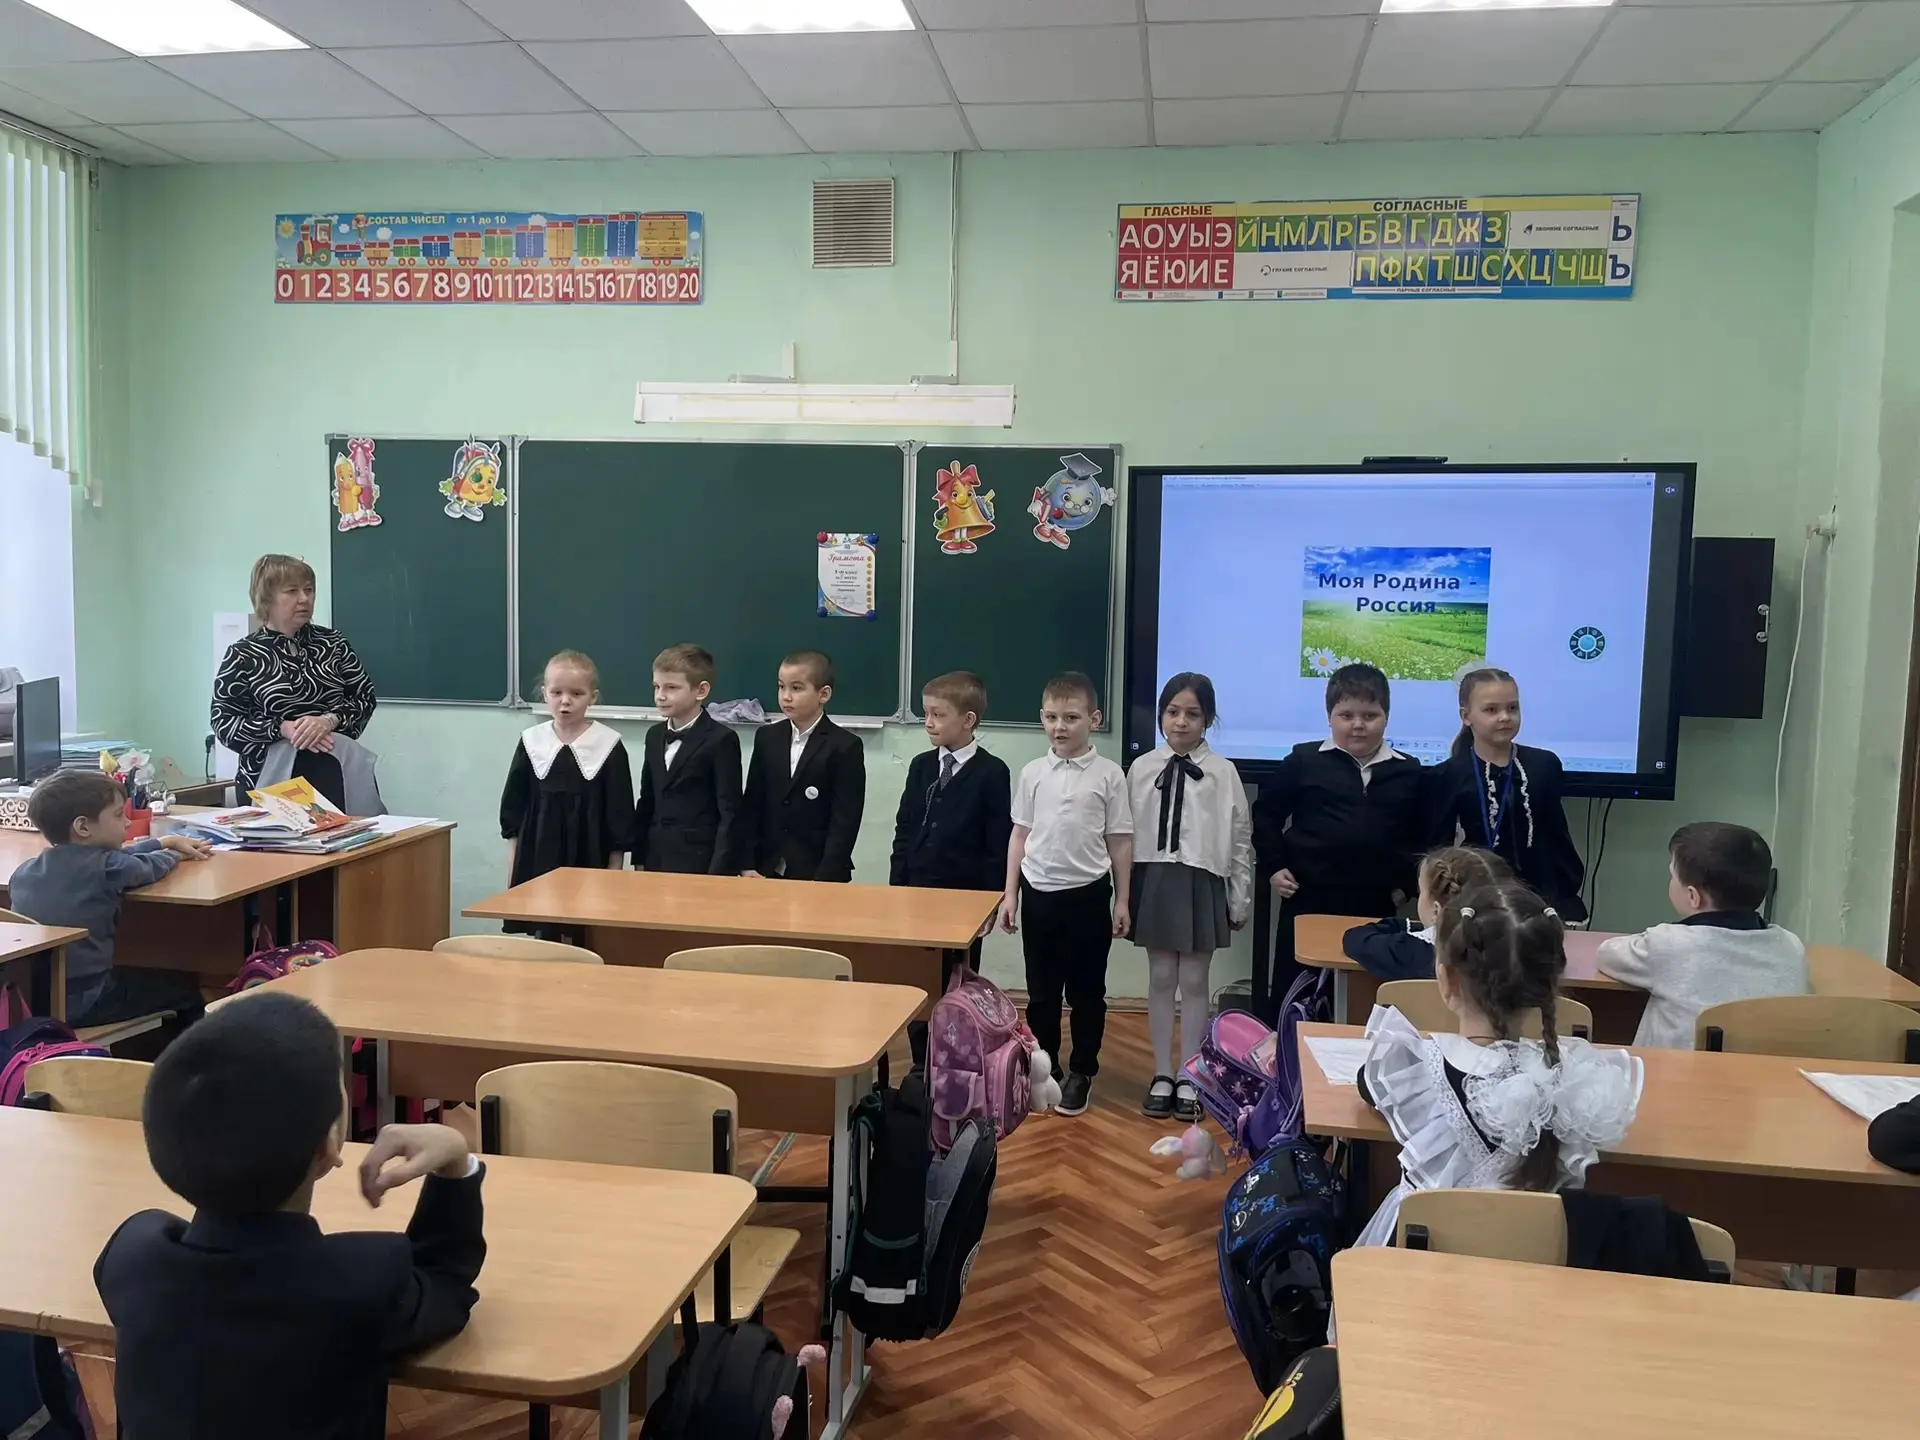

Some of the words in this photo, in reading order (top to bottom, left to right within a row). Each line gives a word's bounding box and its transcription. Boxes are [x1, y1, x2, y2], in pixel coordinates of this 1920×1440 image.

[1144, 205, 1213, 217] ГЛАСНЫЕ
[1373, 199, 1468, 212] СОГЛАСНЫЕ
[368, 216, 409, 225] СОСТАВ
[411, 216, 446, 225] ЧИСЕЛ
[470, 216, 476, 224] 1
[479, 217, 491, 225] до
[495, 216, 507, 224] 10
[1612, 216, 1632, 241] Ь
[1120, 224, 1140, 248] А
[1144, 224, 1164, 248] О
[1168, 224, 1186, 248] У
[1190, 223, 1210, 247] Ы
[1214, 222, 1232, 247] Э
[1238, 218, 1258, 247] Й
[1261, 222, 1280, 246] Н
[1284, 222, 1306, 246] М
[1308, 221, 1329, 245] Л
[1336, 221, 1353, 245] Р
[1358, 220, 1377, 244] Б
[1384, 220, 1401, 244] В
[1410, 219, 1425, 243] Г
[1432, 218, 1453, 246] Д
[1456, 218, 1480, 242] Ж
[1485, 217, 1502, 243] З
[1120, 260, 1138, 284] Я
[1145, 255, 1159, 284] Ё
[1164, 260, 1186, 284] Ю
[1189, 260, 1208, 283] И
[1214, 259, 1229, 283] Е
[1356, 257, 1376, 281] П
[1380, 256, 1401, 282] Ф
[1405, 256, 1424, 281] К
[1432, 256, 1450, 280] Т
[1454, 256, 1477, 281] Ш
[1481, 255, 1500, 280] С
[1505, 255, 1526, 280] Х
[1530, 255, 1550, 284] Ц
[1558, 255, 1577, 280] Ч
[1581, 255, 1603, 283] Щ
[1609, 255, 1630, 280] Ъ
[278, 273, 294, 298] 0
[300, 273, 310, 298] 1
[317, 273, 332, 298] 2
[336, 273, 350, 298] 3
[355, 273, 371, 298] 4
[375, 273, 390, 298] 5
[394, 273, 410, 298] 6
[414, 273, 429, 298] 7
[434, 273, 450, 298] 8
[454, 273, 470, 298] 9
[474, 273, 492, 298] 10
[494, 273, 512, 298] 11
[515, 273, 534, 298] 12
[535, 273, 553, 298] 13
[555, 273, 574, 298] 14
[576, 273, 595, 298] 15
[596, 273, 615, 298] 16
[616, 273, 636, 298] 17
[637, 273, 656, 298] 18
[658, 273, 678, 298] 19
[679, 273, 699, 298] 20
[828, 554, 865, 563] Грамота
[1319, 573, 1364, 589] Моя
[1373, 573, 1460, 592] Родина
[1356, 597, 1436, 613] Россия
